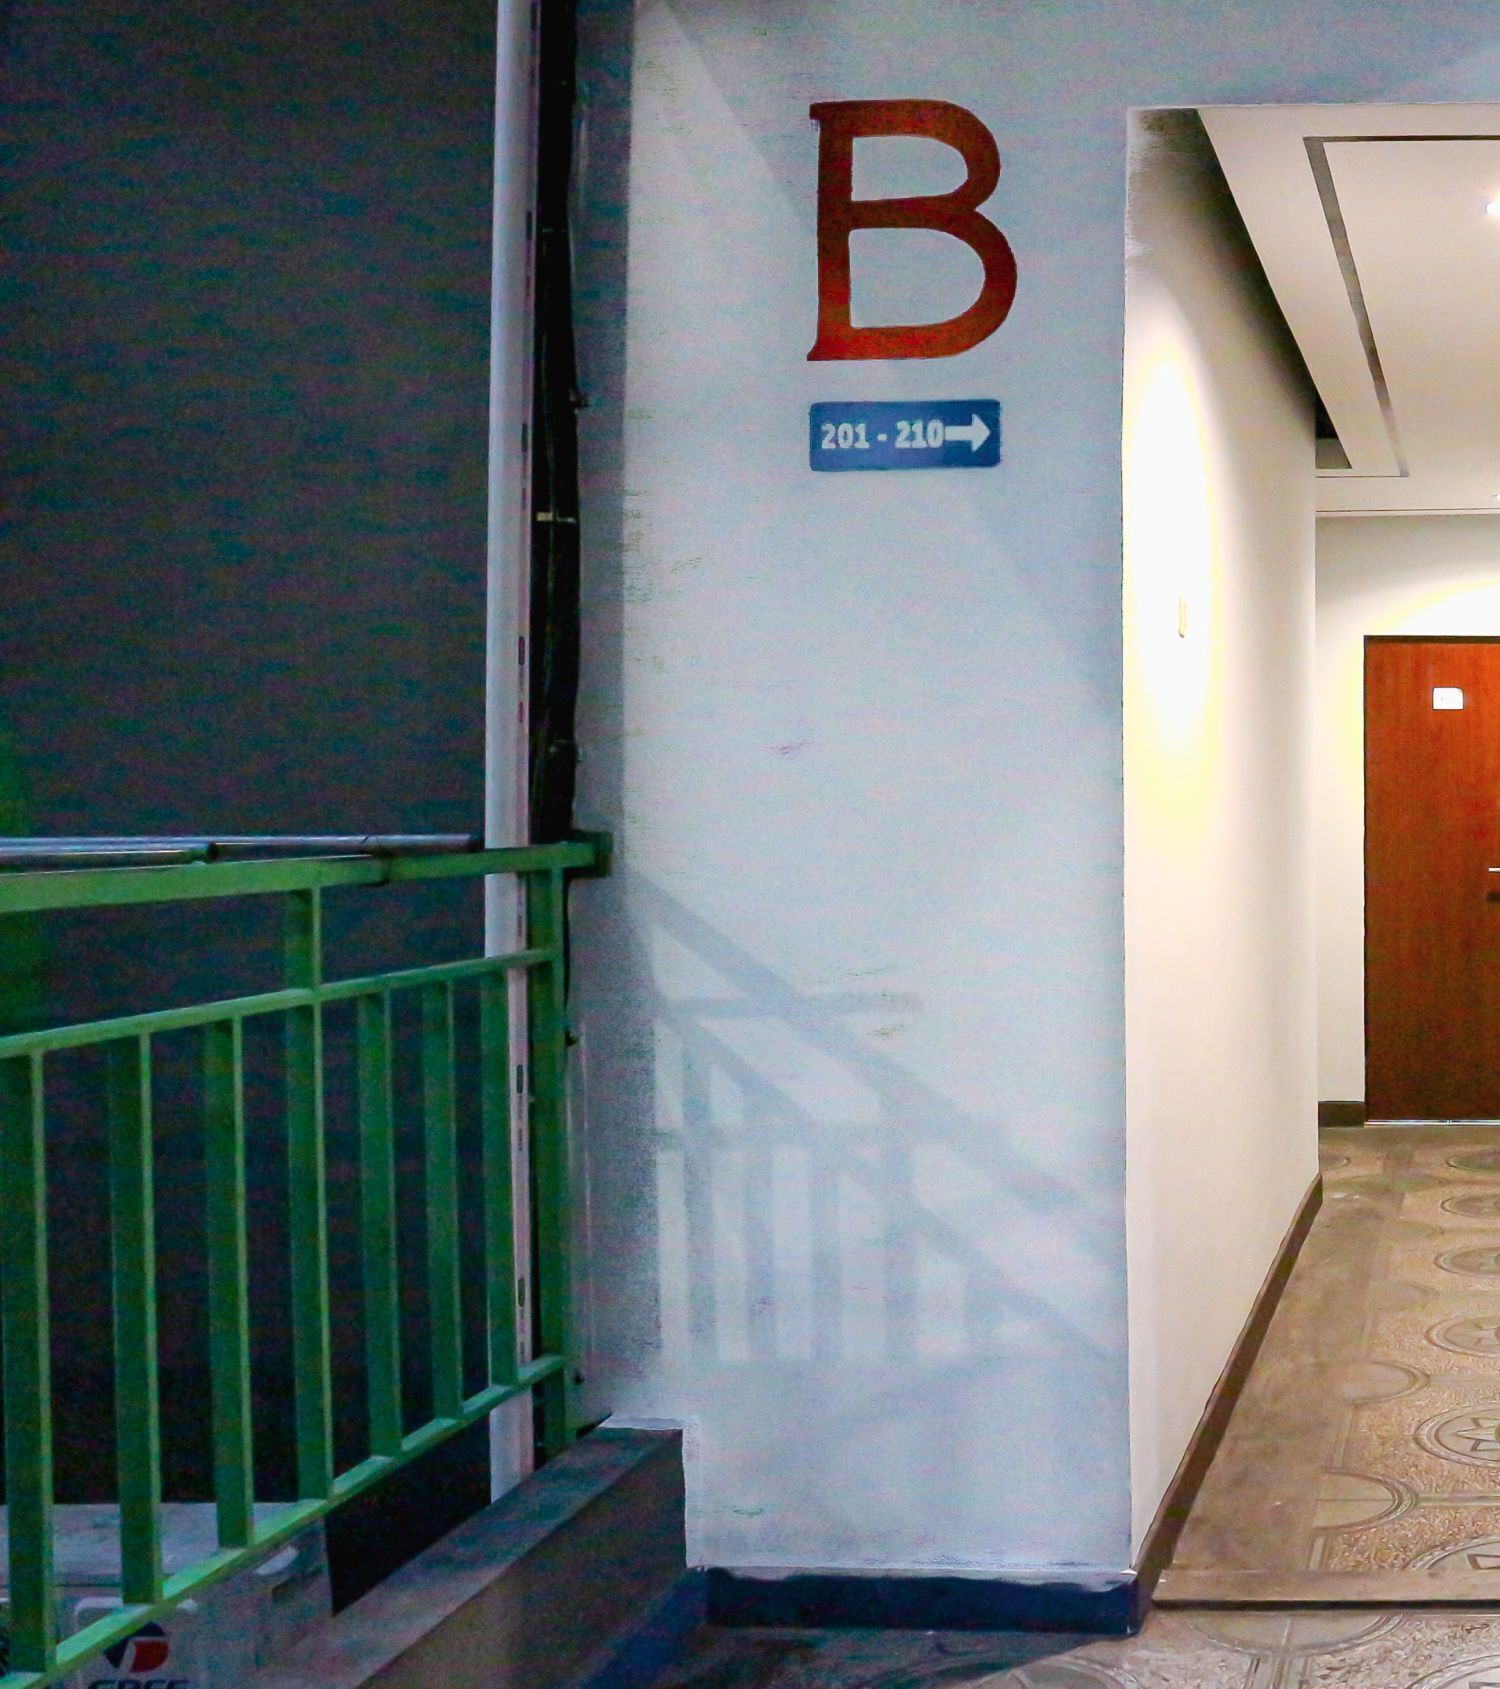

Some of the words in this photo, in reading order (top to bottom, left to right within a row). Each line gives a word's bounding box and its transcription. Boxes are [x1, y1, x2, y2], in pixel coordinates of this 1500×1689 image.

[807, 99, 1017, 361] B
[821, 422, 870, 449] 201
[895, 419, 945, 449] 210
